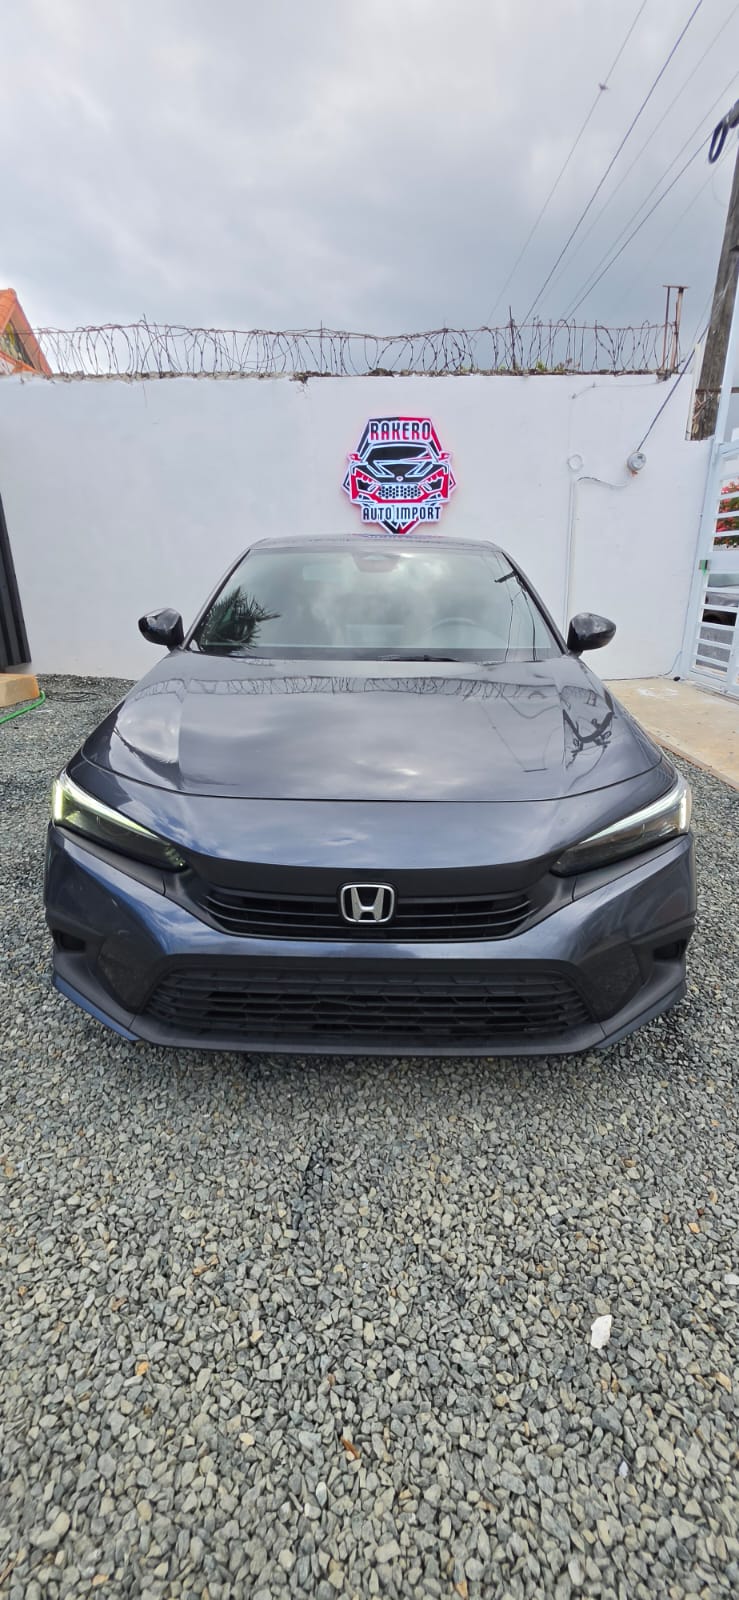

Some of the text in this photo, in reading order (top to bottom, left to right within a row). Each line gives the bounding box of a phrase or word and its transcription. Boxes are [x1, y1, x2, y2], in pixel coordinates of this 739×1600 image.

[370, 422, 431, 440] RAKERO
[363, 507, 441, 520] AUTO IMPORT
